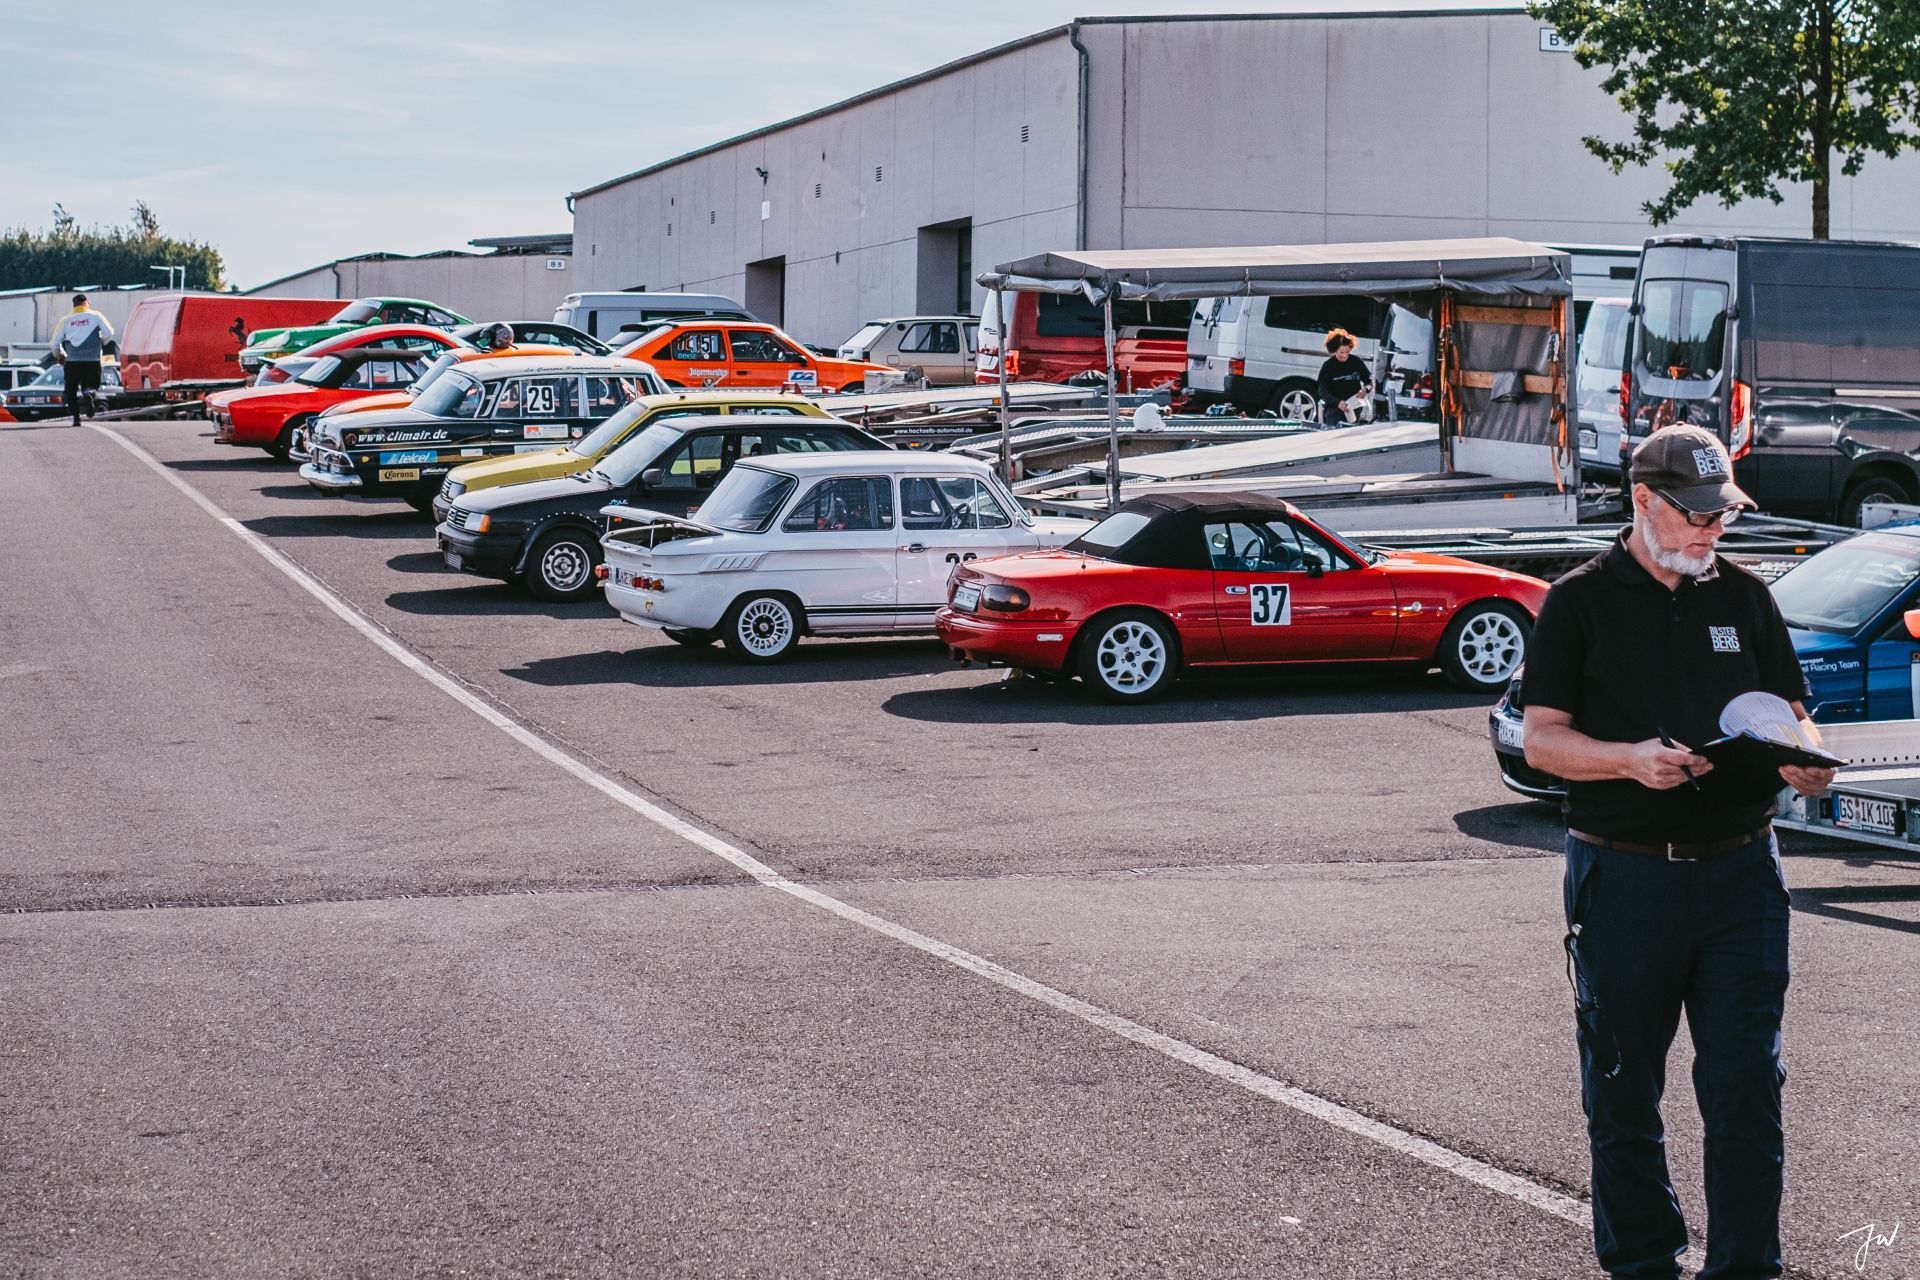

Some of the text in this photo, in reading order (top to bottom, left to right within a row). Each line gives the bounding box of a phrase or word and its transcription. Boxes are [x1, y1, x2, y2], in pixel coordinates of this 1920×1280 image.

[528, 386, 553, 411] 29
[358, 428, 448, 442] www.climair.de
[384, 470, 414, 480] Corona
[1252, 585, 1288, 623] 37
[1709, 626, 1737, 636] BILSTER
[1712, 635, 1740, 649] BERG
[1810, 663, 1837, 672] Racing
[1838, 660, 1859, 669] Team
[1839, 798, 1854, 820] GS
[1861, 801, 1875, 824] IK
